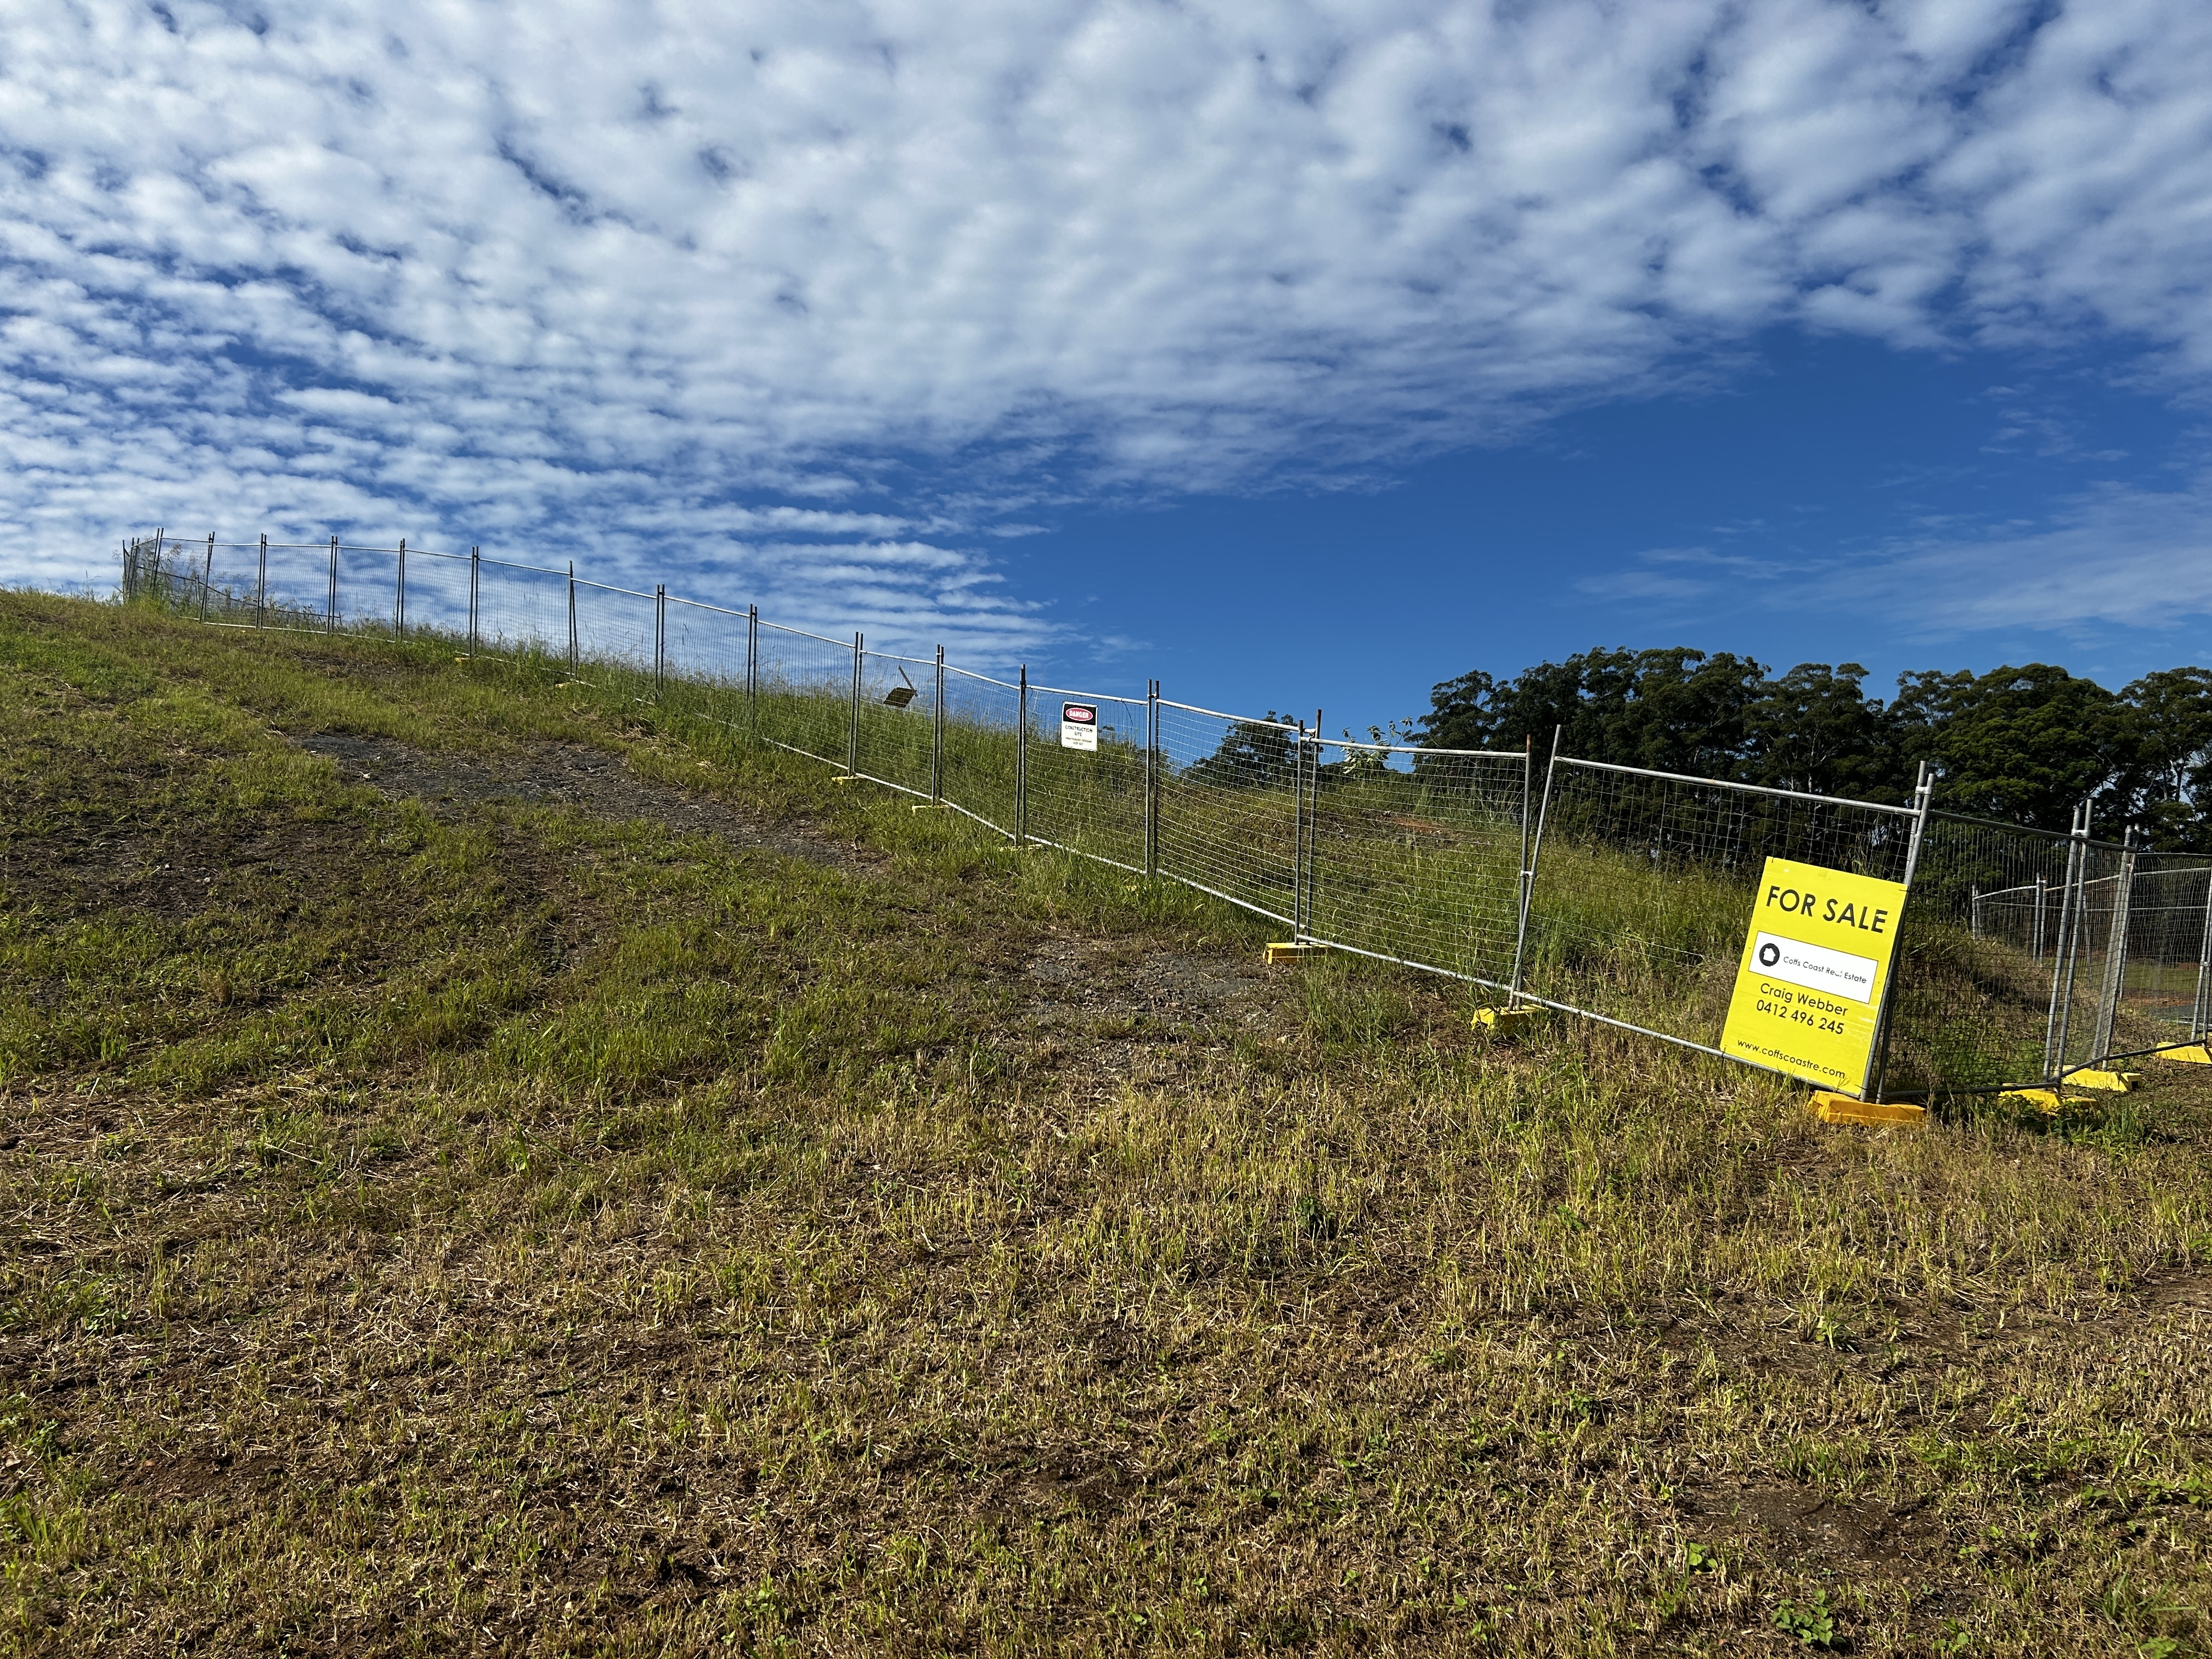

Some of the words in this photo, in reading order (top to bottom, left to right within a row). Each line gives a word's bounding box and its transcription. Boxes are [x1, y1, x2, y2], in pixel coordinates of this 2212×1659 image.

[1069, 710, 1089, 719] DANGER
[1766, 885, 1816, 917] FOR
[1822, 898, 1888, 933] SALE
[1783, 956, 1801, 967] Coffs
[1803, 961, 1824, 973] Coast
[1844, 972, 1867, 984] Estate
[1760, 983, 1793, 1003] Craig
[1797, 992, 1848, 1017] Webber
[1757, 1000, 1787, 1019] 0412
[1791, 1009, 1814, 1027] 496
[1818, 1017, 1844, 1035] 245
[1737, 1040, 1846, 1079] www.coffscoastre.com
